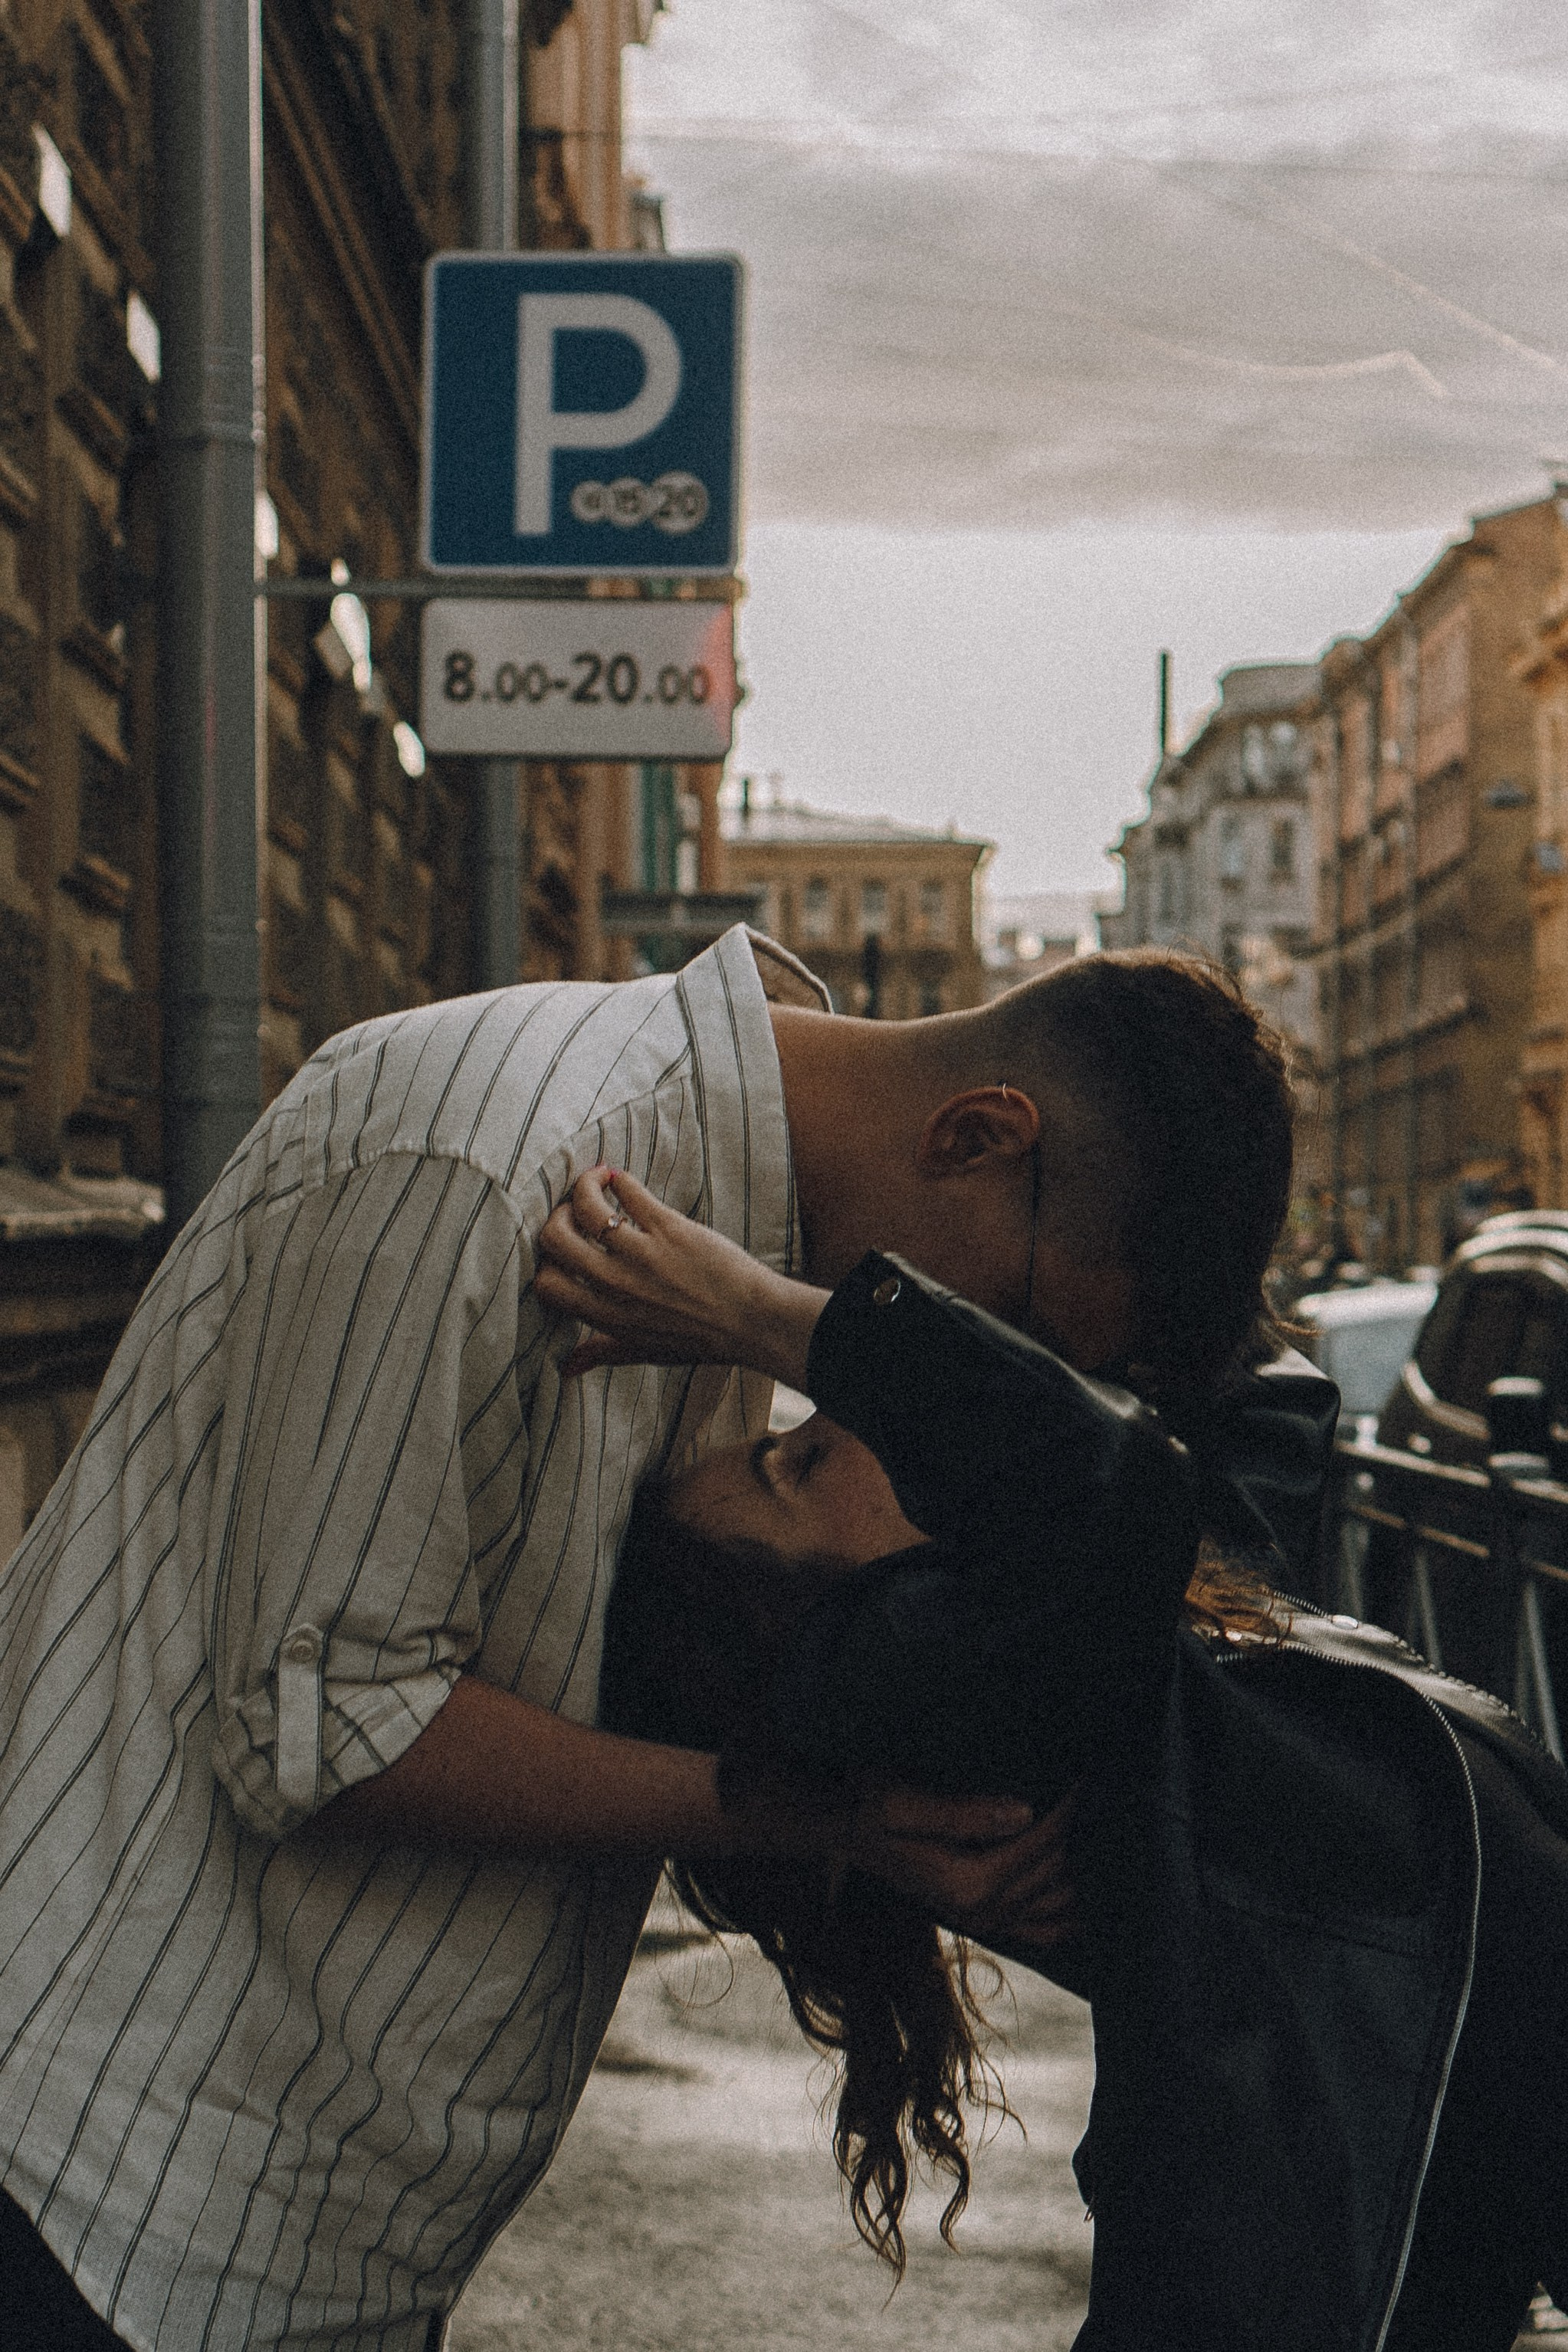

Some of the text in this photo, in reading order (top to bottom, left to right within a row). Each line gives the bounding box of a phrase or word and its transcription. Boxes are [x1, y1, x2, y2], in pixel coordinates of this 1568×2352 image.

[515, 293, 682, 536] P
[658, 483, 704, 519] 20
[443, 650, 710, 705] 8.00-20.00
